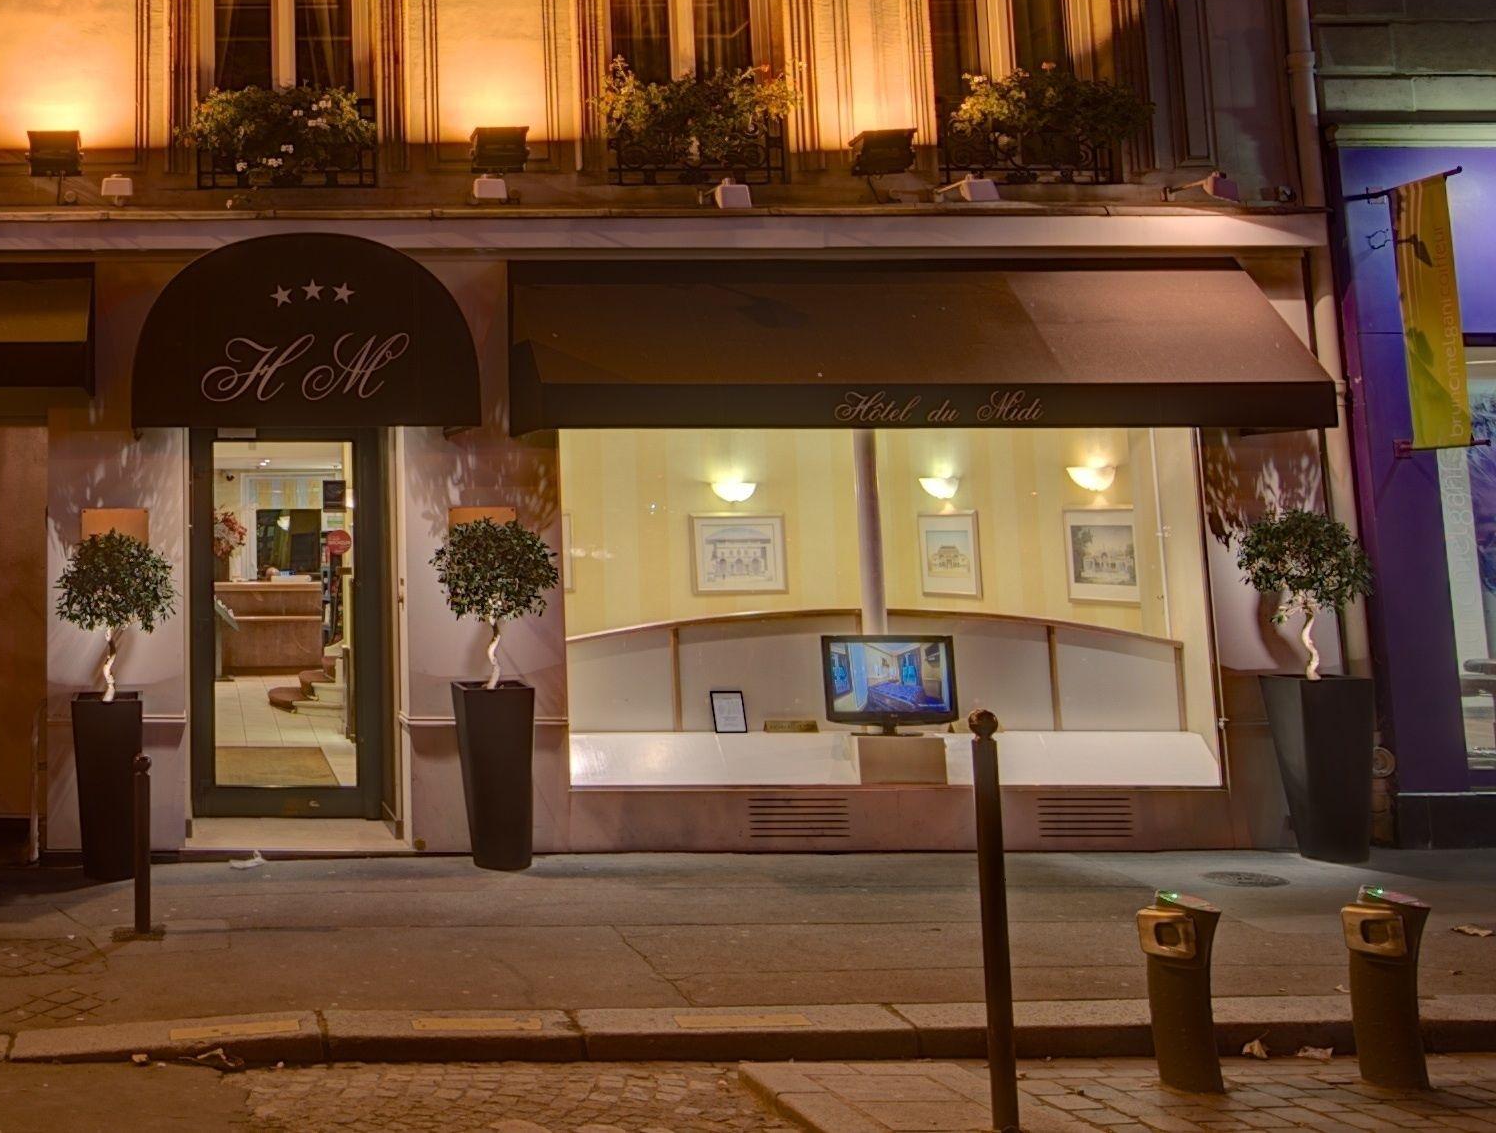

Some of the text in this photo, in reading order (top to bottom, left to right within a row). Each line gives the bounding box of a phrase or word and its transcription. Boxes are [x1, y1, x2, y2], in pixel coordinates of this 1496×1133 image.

[834, 389, 1045, 423] Hôtel du Midi
